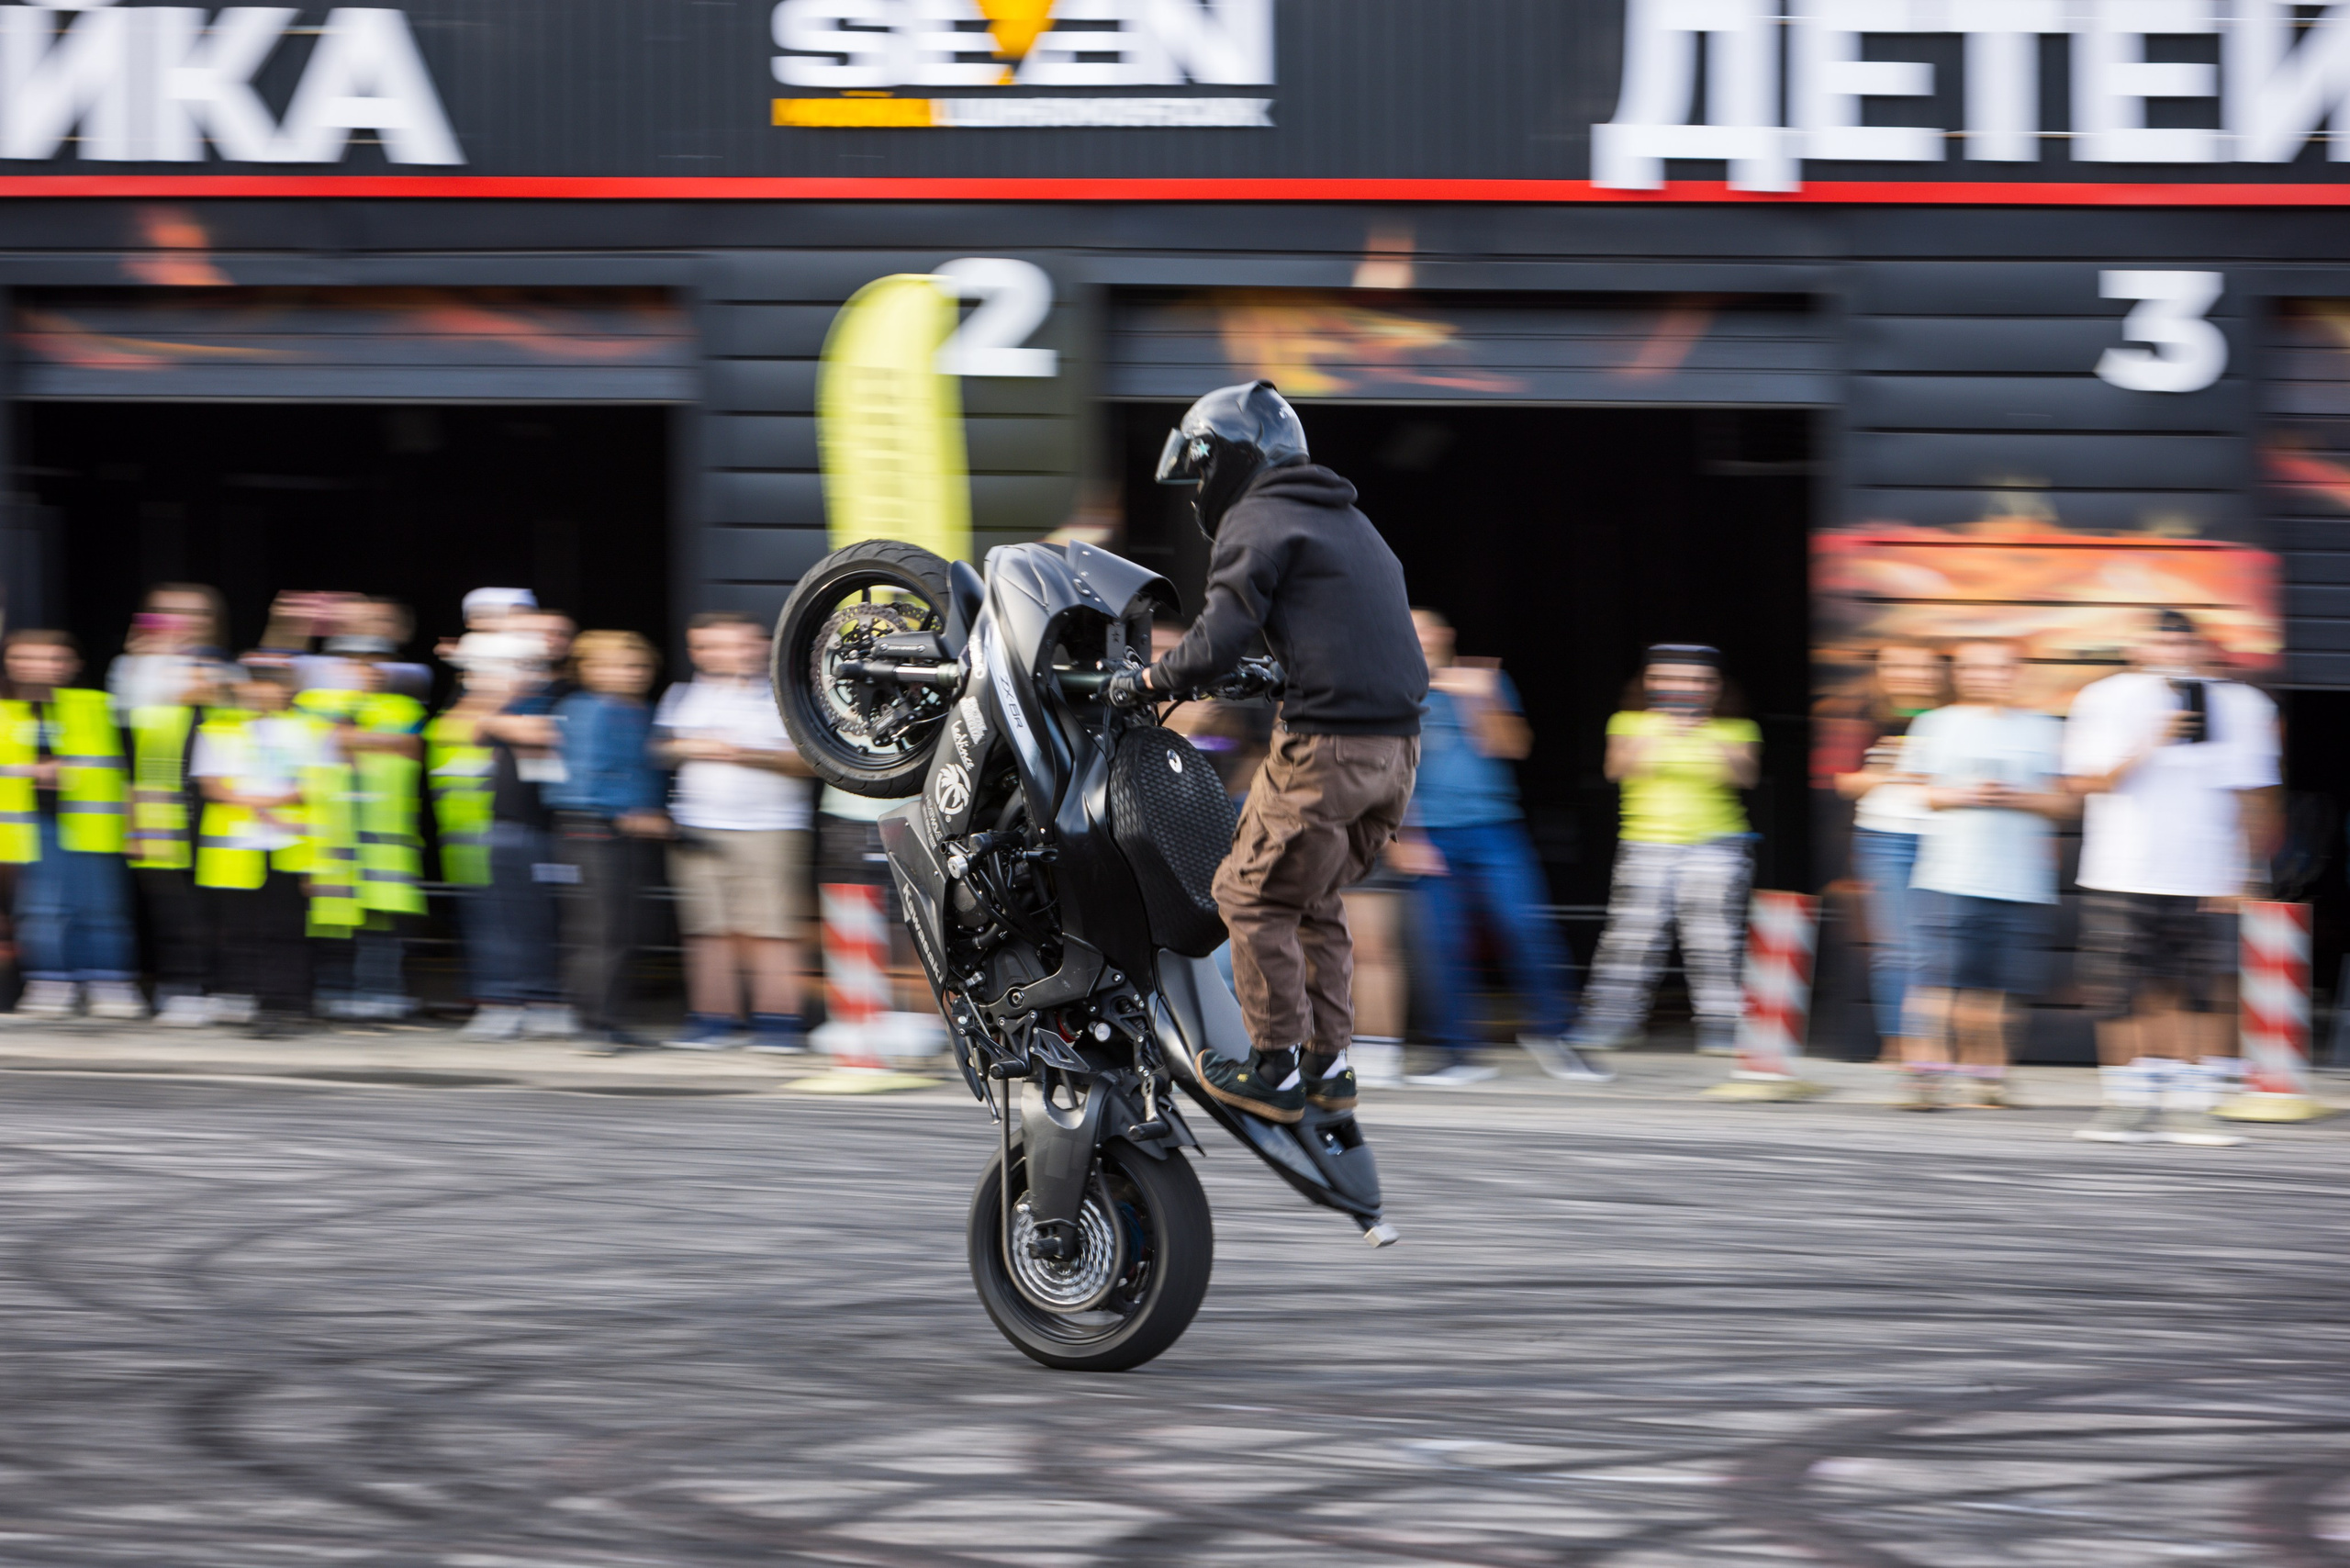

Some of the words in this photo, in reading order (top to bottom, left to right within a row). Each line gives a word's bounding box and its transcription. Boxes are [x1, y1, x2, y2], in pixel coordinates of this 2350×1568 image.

[929, 257, 1059, 376] 2
[2095, 270, 2228, 392] 3
[902, 882, 945, 984] Kawasaki
